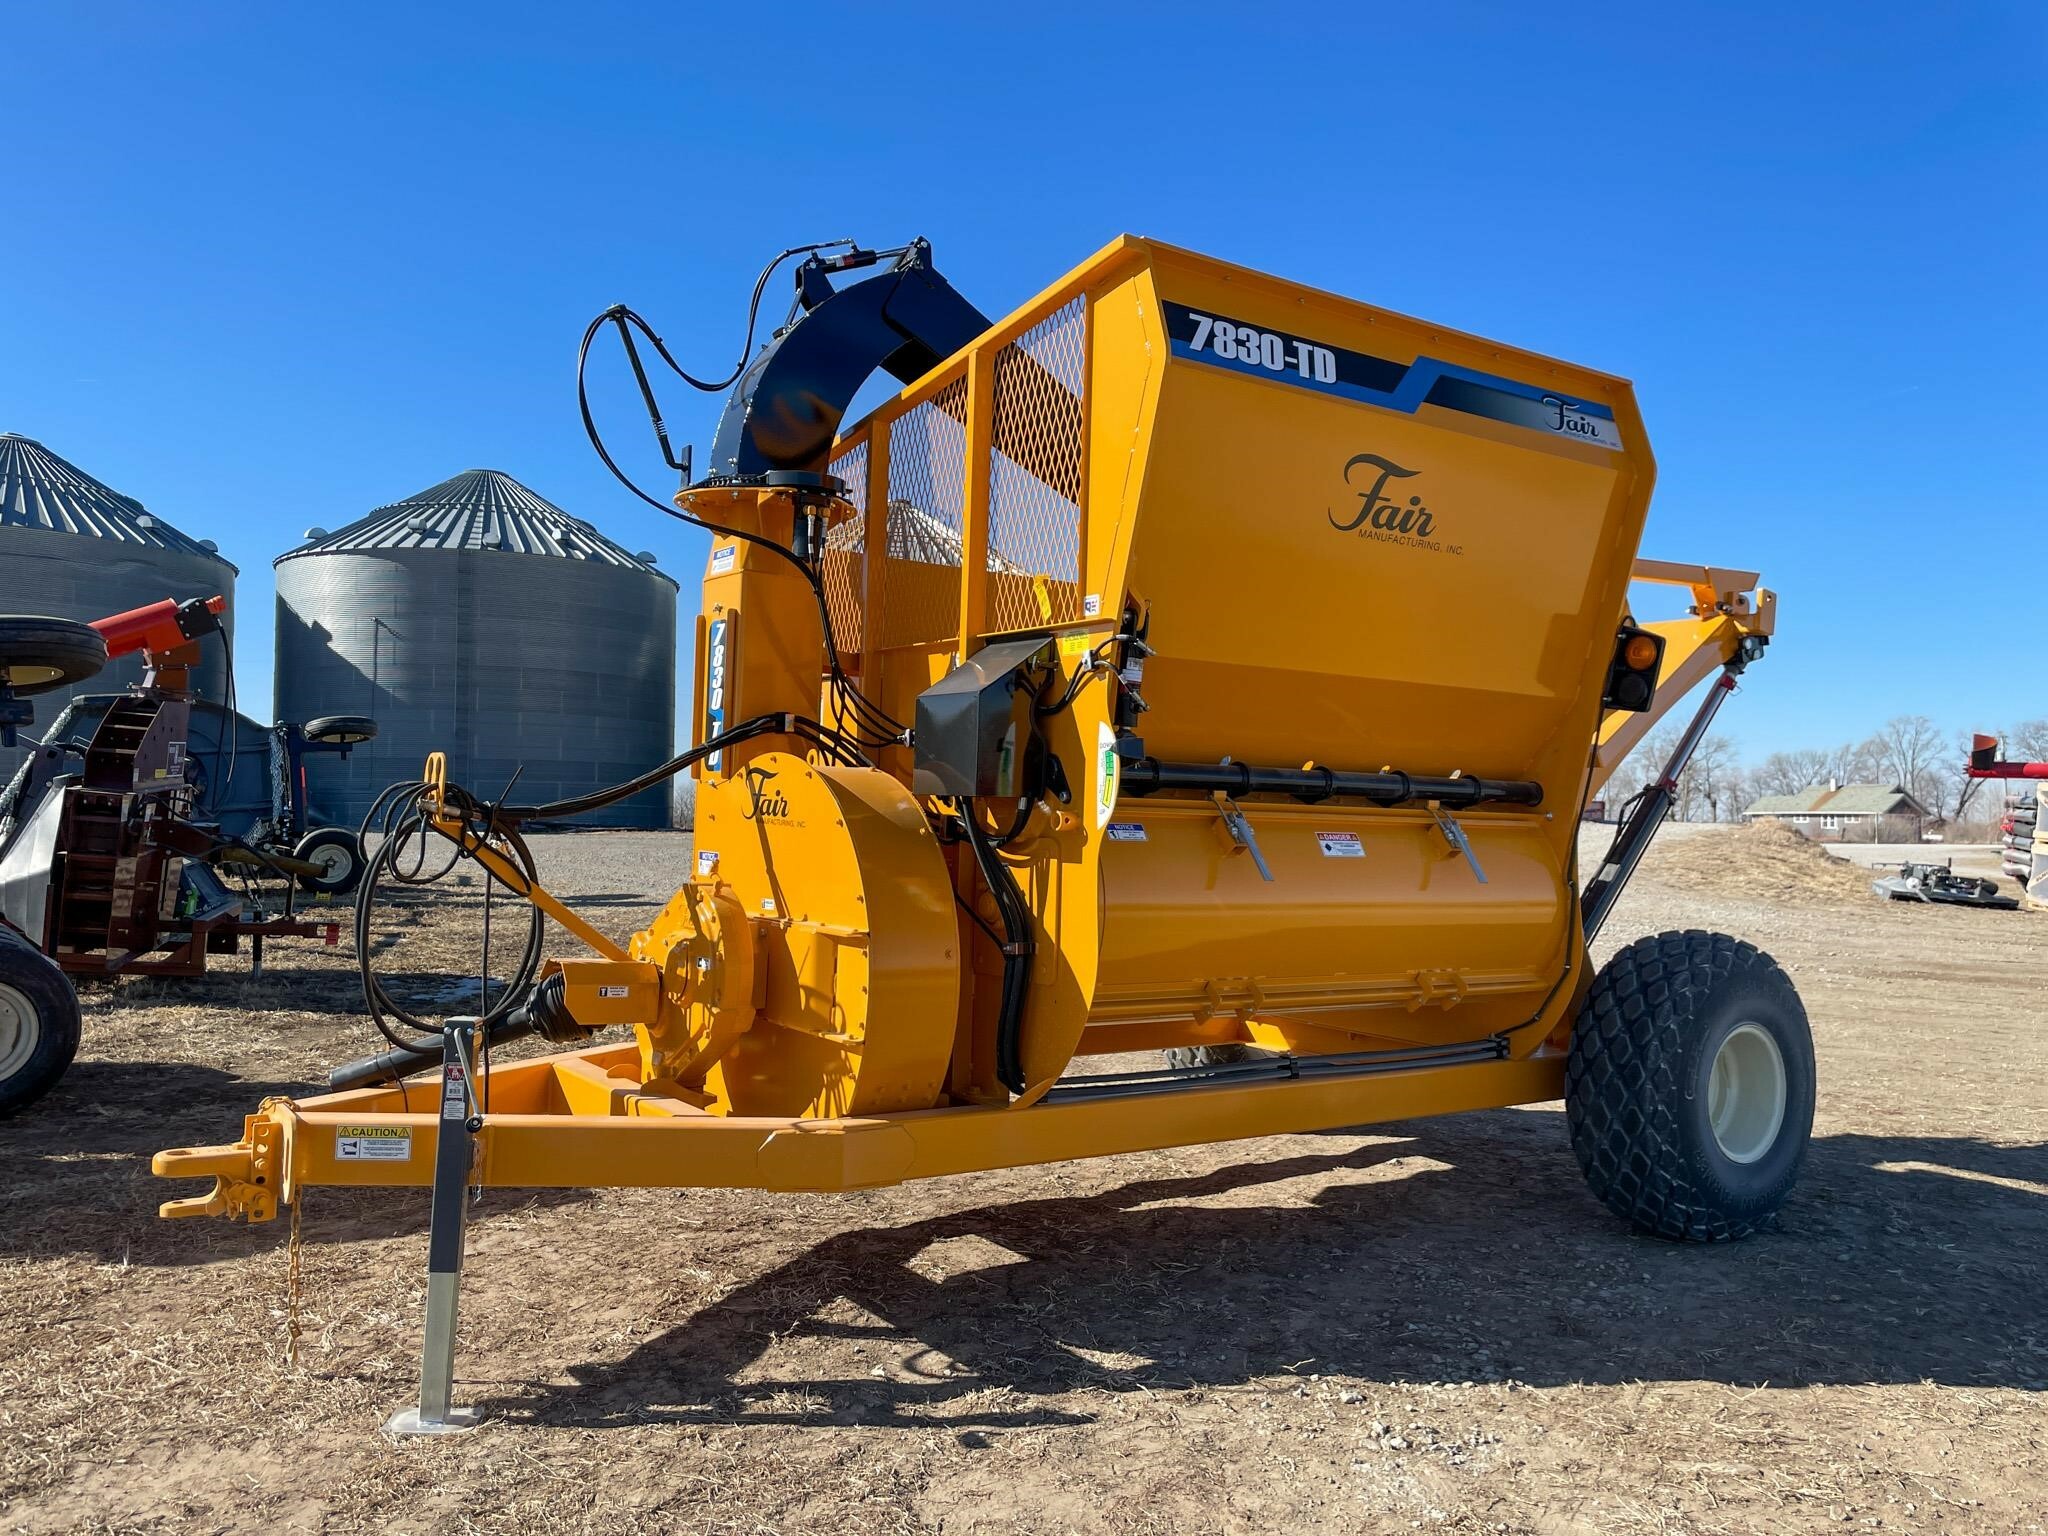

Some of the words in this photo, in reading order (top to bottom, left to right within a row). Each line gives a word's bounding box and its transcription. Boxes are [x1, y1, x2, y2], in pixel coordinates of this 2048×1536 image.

[1188, 312, 1337, 385] 7830-TD
[1541, 393, 1600, 437] Fair
[1327, 453, 1437, 538] Fair
[1446, 544, 1465, 556] INC.
[711, 622, 726, 711] 7830
[741, 767, 790, 820] Fair
[351, 1128, 398, 1137] CAUTION
